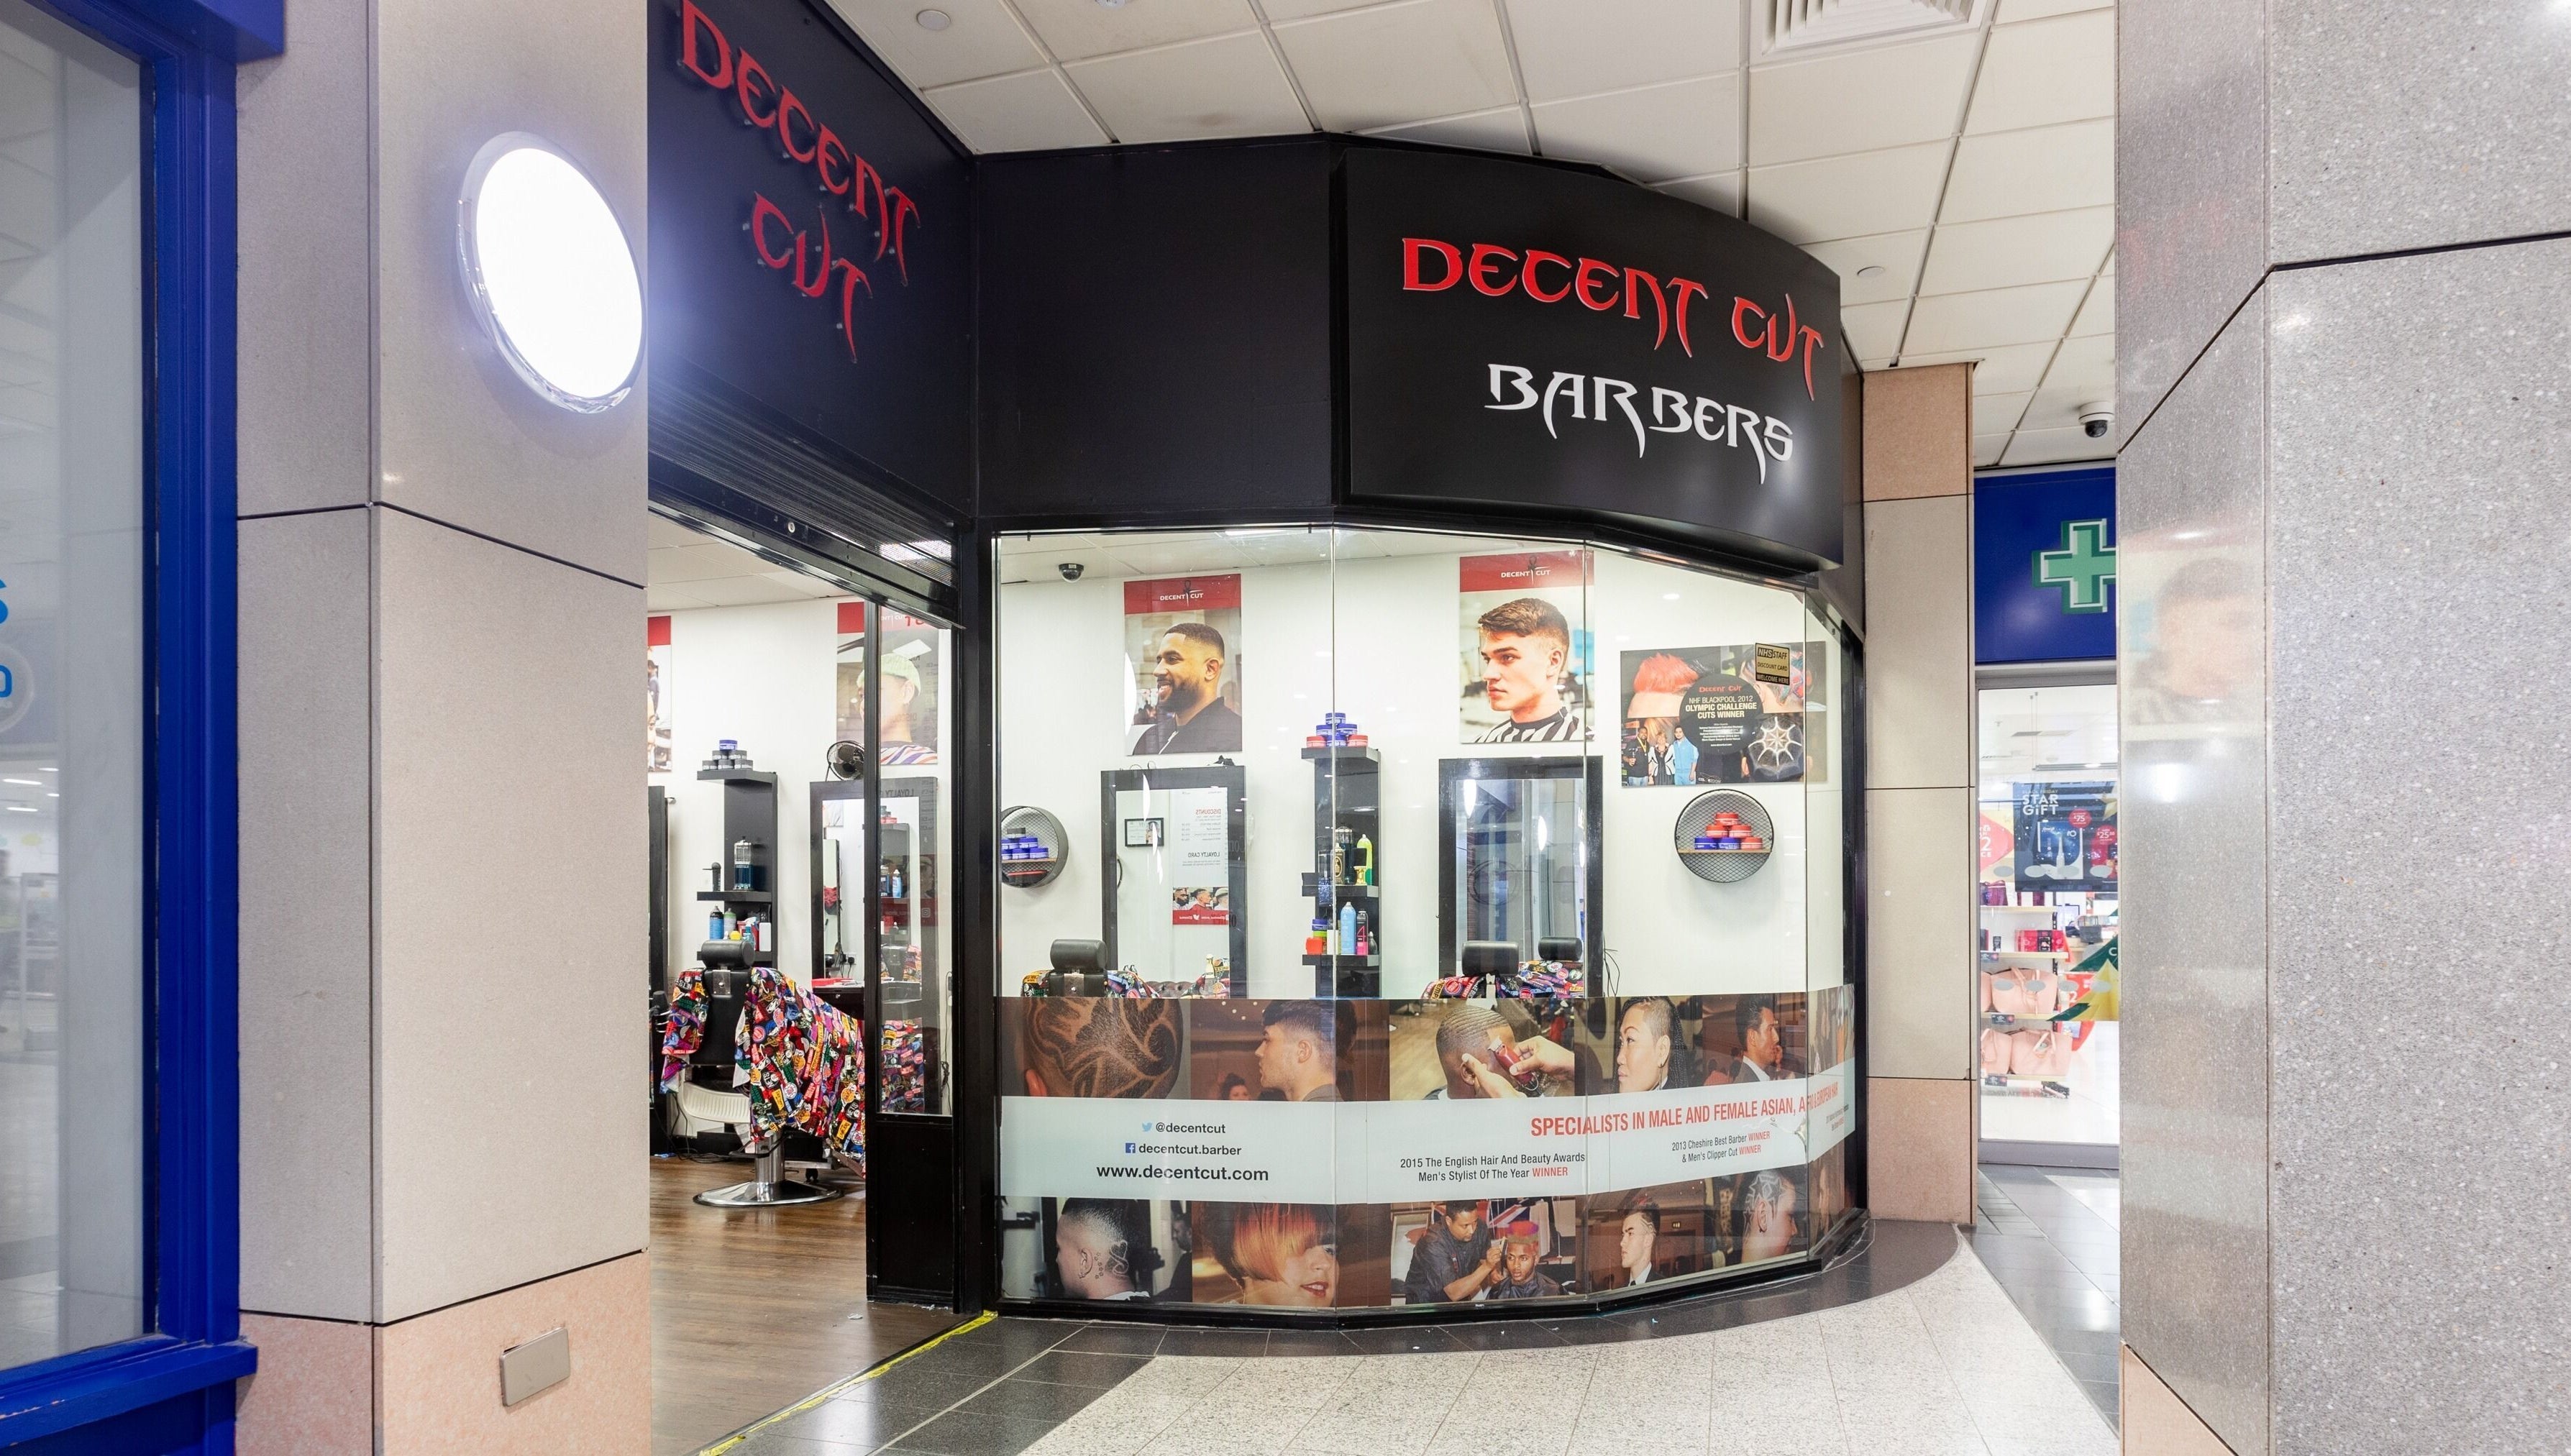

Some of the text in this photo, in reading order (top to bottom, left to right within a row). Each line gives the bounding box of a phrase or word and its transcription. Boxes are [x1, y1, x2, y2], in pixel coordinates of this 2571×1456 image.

[682, 0, 921, 286] DECENT
[752, 191, 873, 364] CUT
[1402, 238, 1824, 401] DECENT CUT
[1484, 363, 1794, 485] BARBERS
[1758, 648, 1788, 659] NHS STAFF
[1756, 674, 1778, 682] WELCOME
[2022, 794, 2058, 805] STAR
[1531, 1112, 1628, 1136] SPECIALISTS
[1632, 1112, 1645, 1130] IN
[1649, 1107, 1682, 1127] MALE
[1686, 1105, 1710, 1124] AND
[1714, 1100, 1758, 1121] FEMALE
[1761, 1096, 1796, 1116] ASIAN,
[1155, 1122, 1226, 1134] @decentcut
[1138, 1143, 1242, 1155] decentcut.barber
[1672, 1130, 1771, 1151] 2013 Cheshire Best Barber WINNER
[1400, 1153, 1585, 1168] 2015 The English Hair And Beauty Awards
[1681, 1144, 1761, 1163] & Men's Clipper Cut WINNER
[1096, 1164, 1269, 1181] www.decentcut.com
[1418, 1167, 1568, 1182] Men's Stylist Of The Year WINNER
